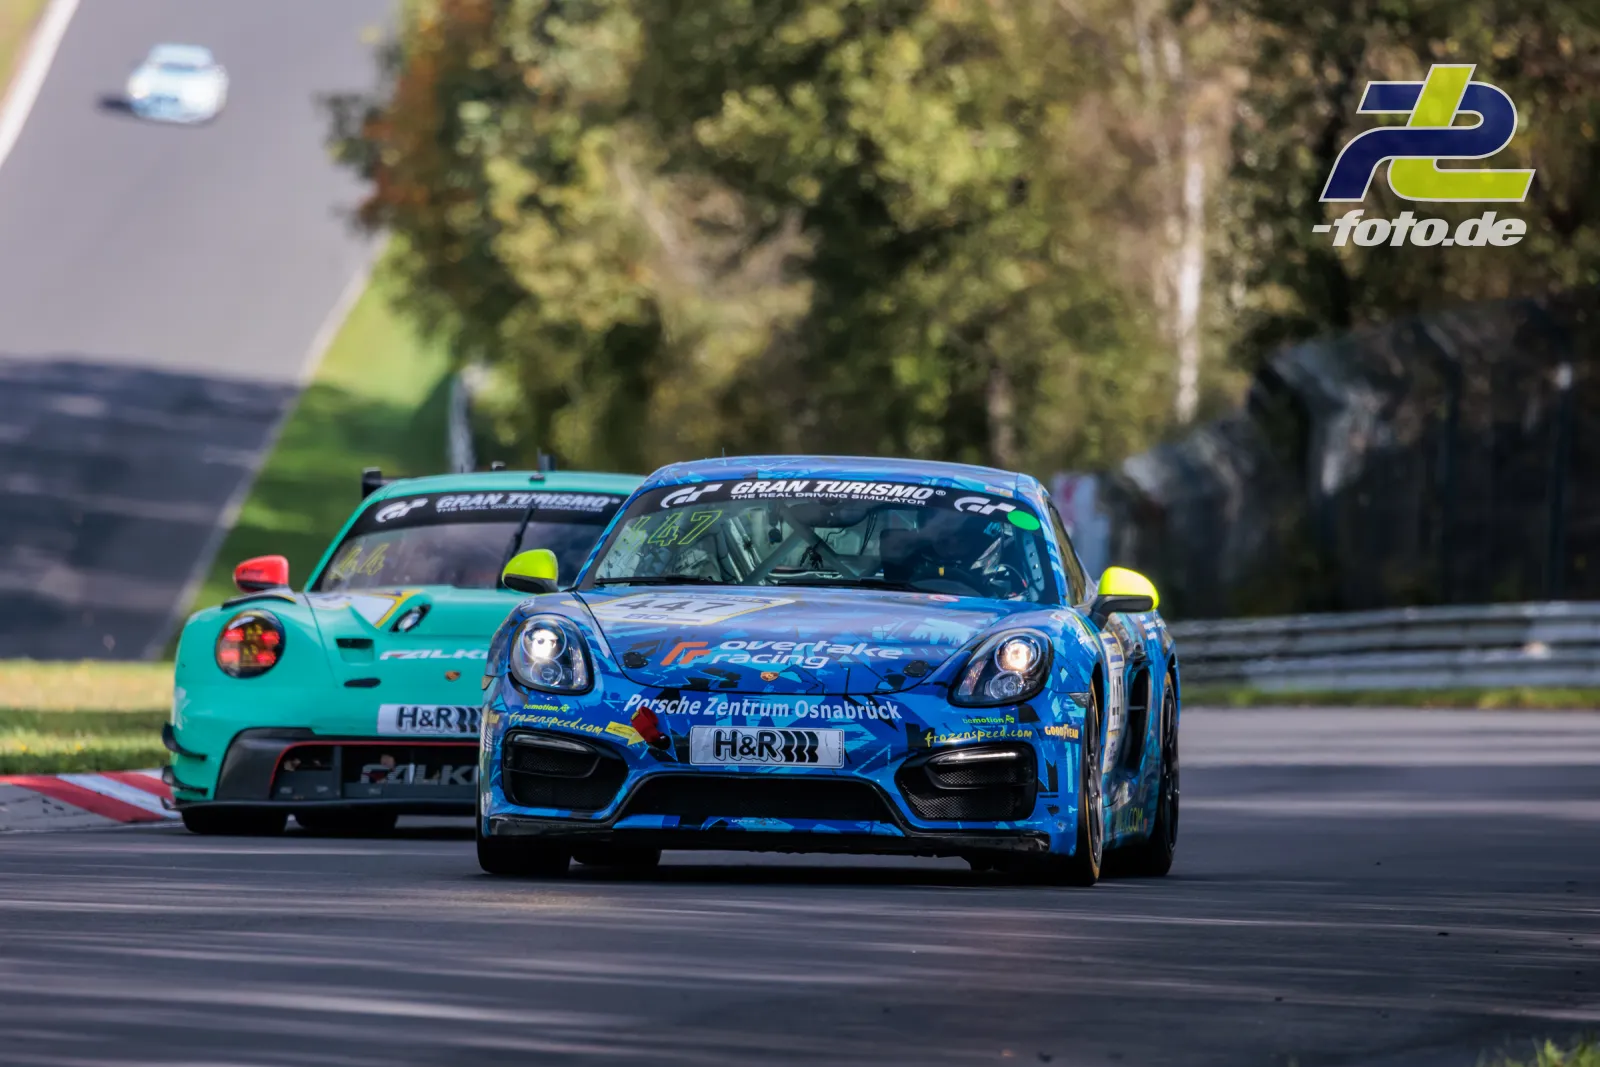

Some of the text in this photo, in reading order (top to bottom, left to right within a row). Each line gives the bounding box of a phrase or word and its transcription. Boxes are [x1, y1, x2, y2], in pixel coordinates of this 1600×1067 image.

[730, 480, 810, 494] GRAN
[436, 494, 504, 509] GRAN
[851, 494, 926, 506] SIMULATOR
[616, 600, 735, 613] 447
[711, 651, 830, 669] racing
[719, 640, 904, 660] overtake
[703, 697, 789, 718] Zentrum
[794, 699, 902, 720] Osnabrück
[396, 706, 454, 732] H&R
[508, 711, 604, 737] frozenspeed.com
[713, 729, 781, 761] H&R
[924, 726, 1033, 748] frozenspeed.com
